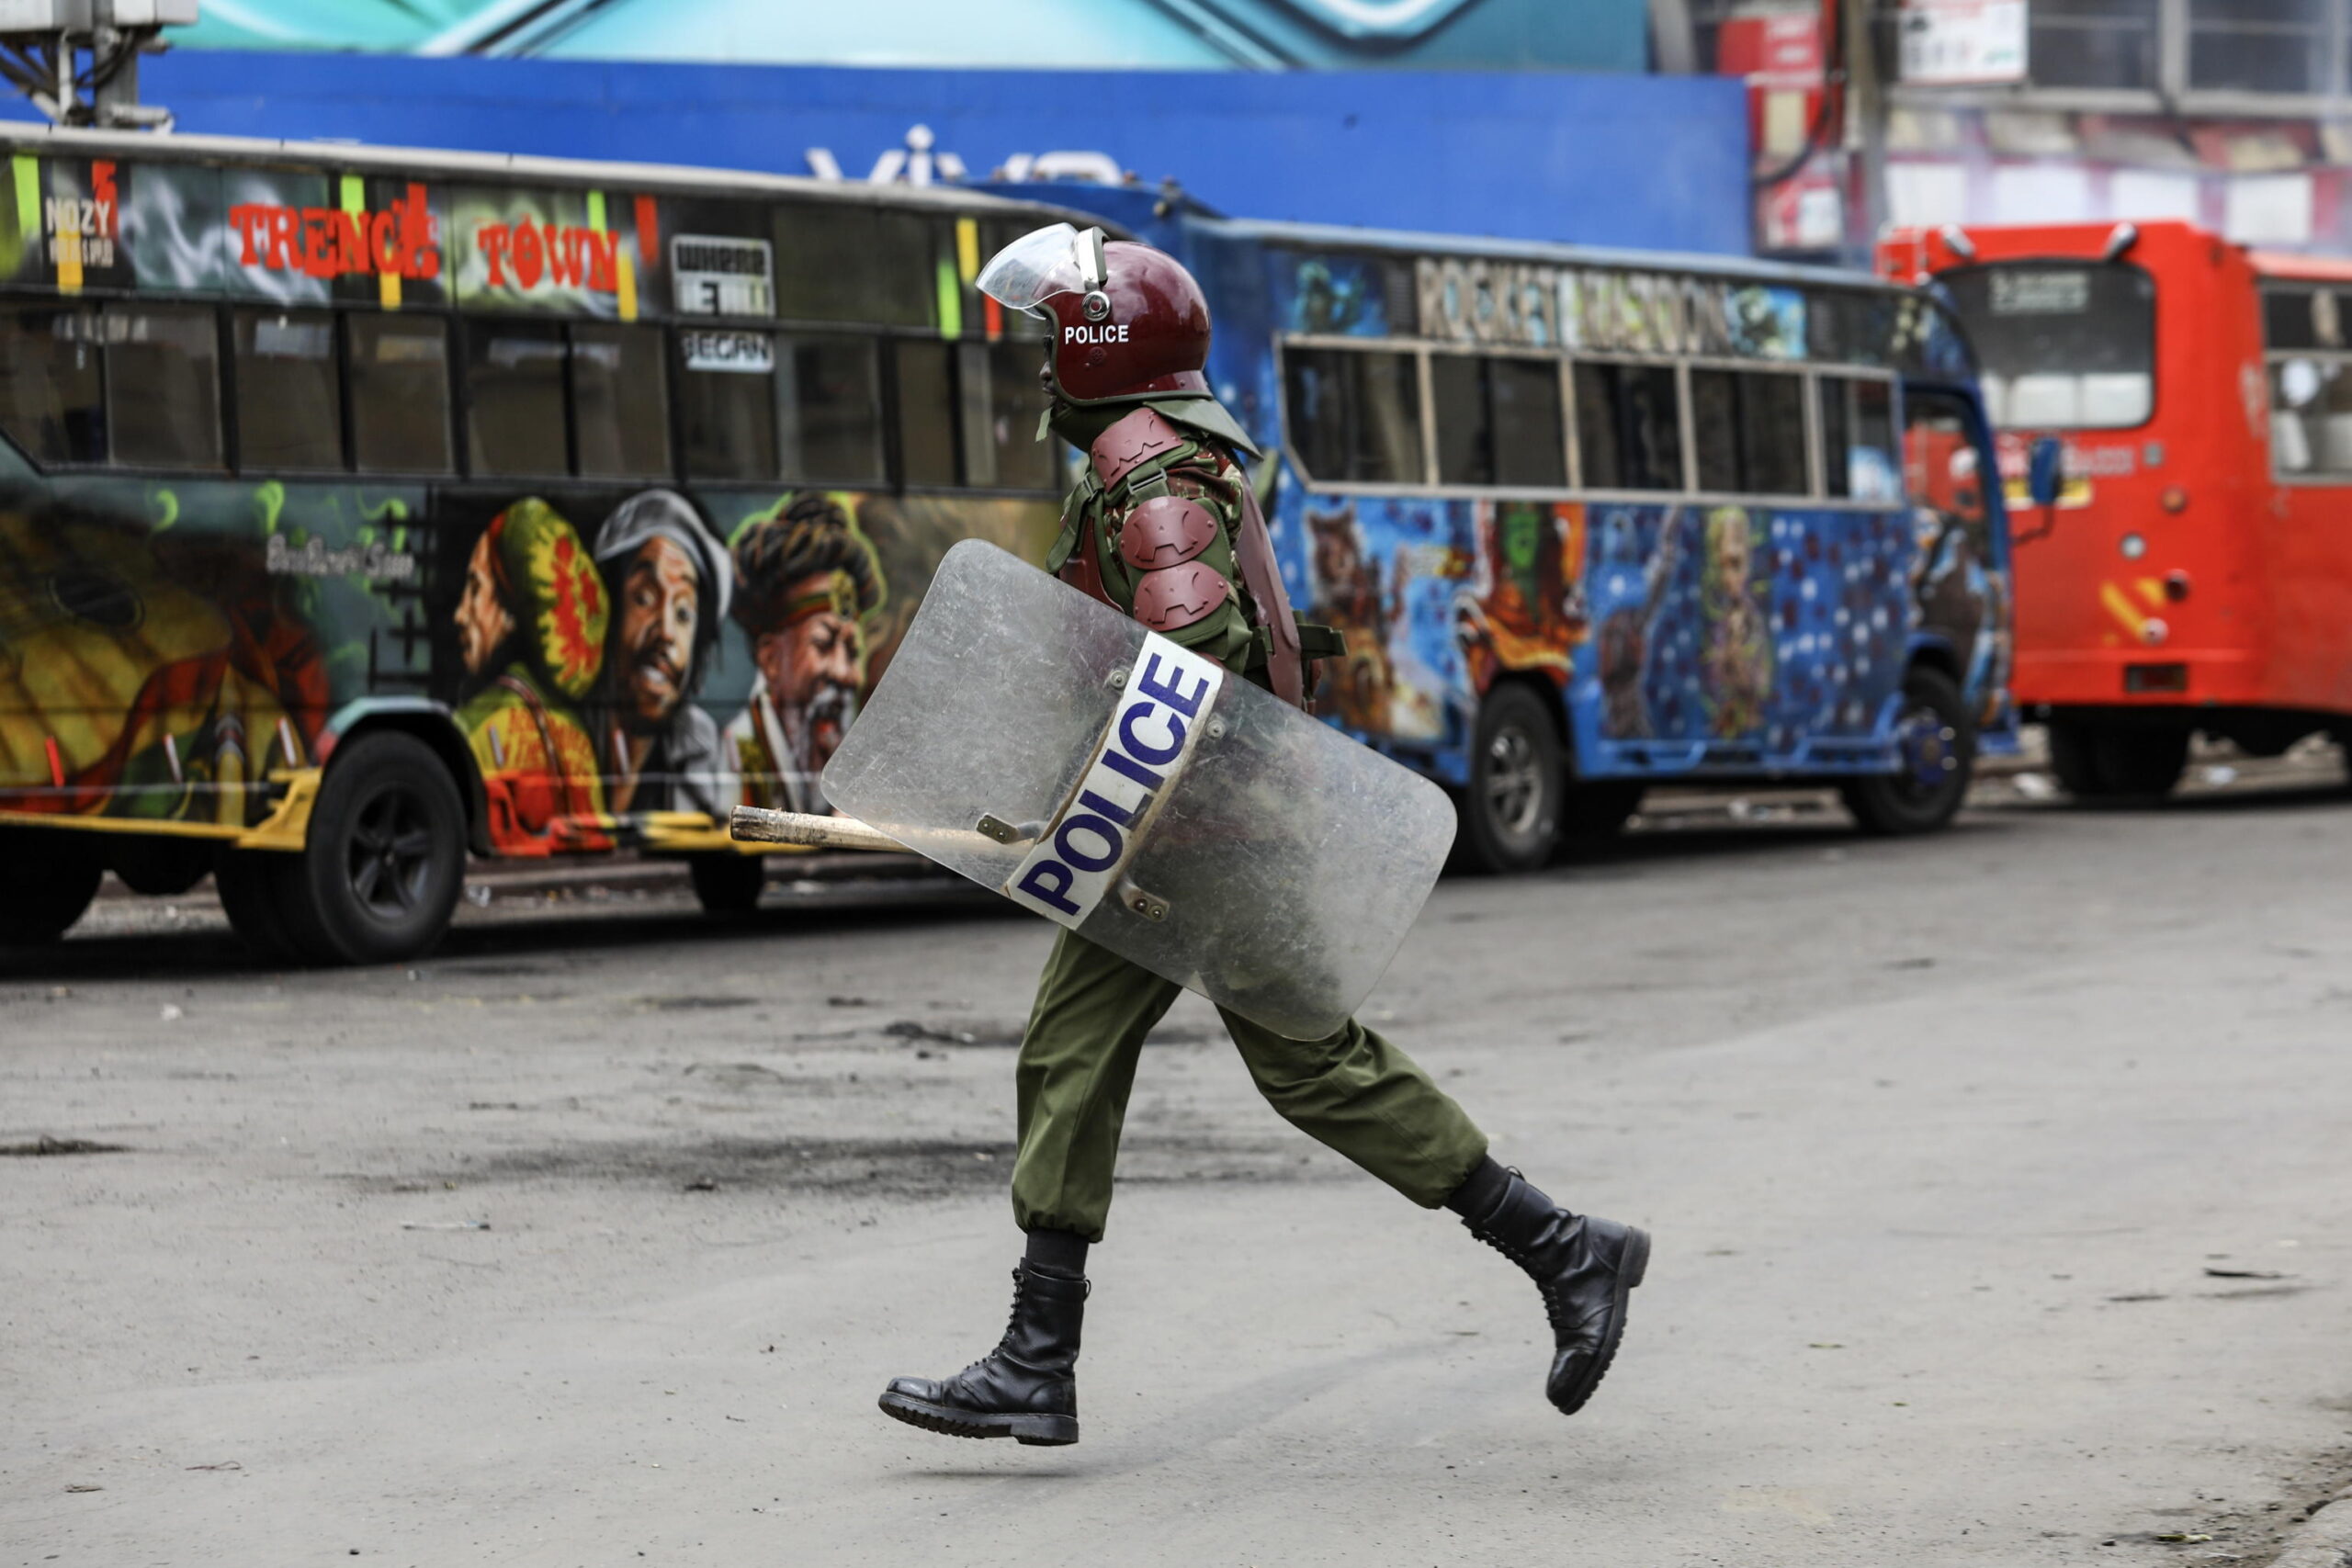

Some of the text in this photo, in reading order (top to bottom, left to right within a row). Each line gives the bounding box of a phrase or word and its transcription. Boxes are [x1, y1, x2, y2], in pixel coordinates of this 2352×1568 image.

[46, 197, 110, 236] NOZY
[478, 220, 619, 293] TOWN
[1065, 324, 1129, 345] POLICE
[1017, 652, 1210, 917] POLICE
